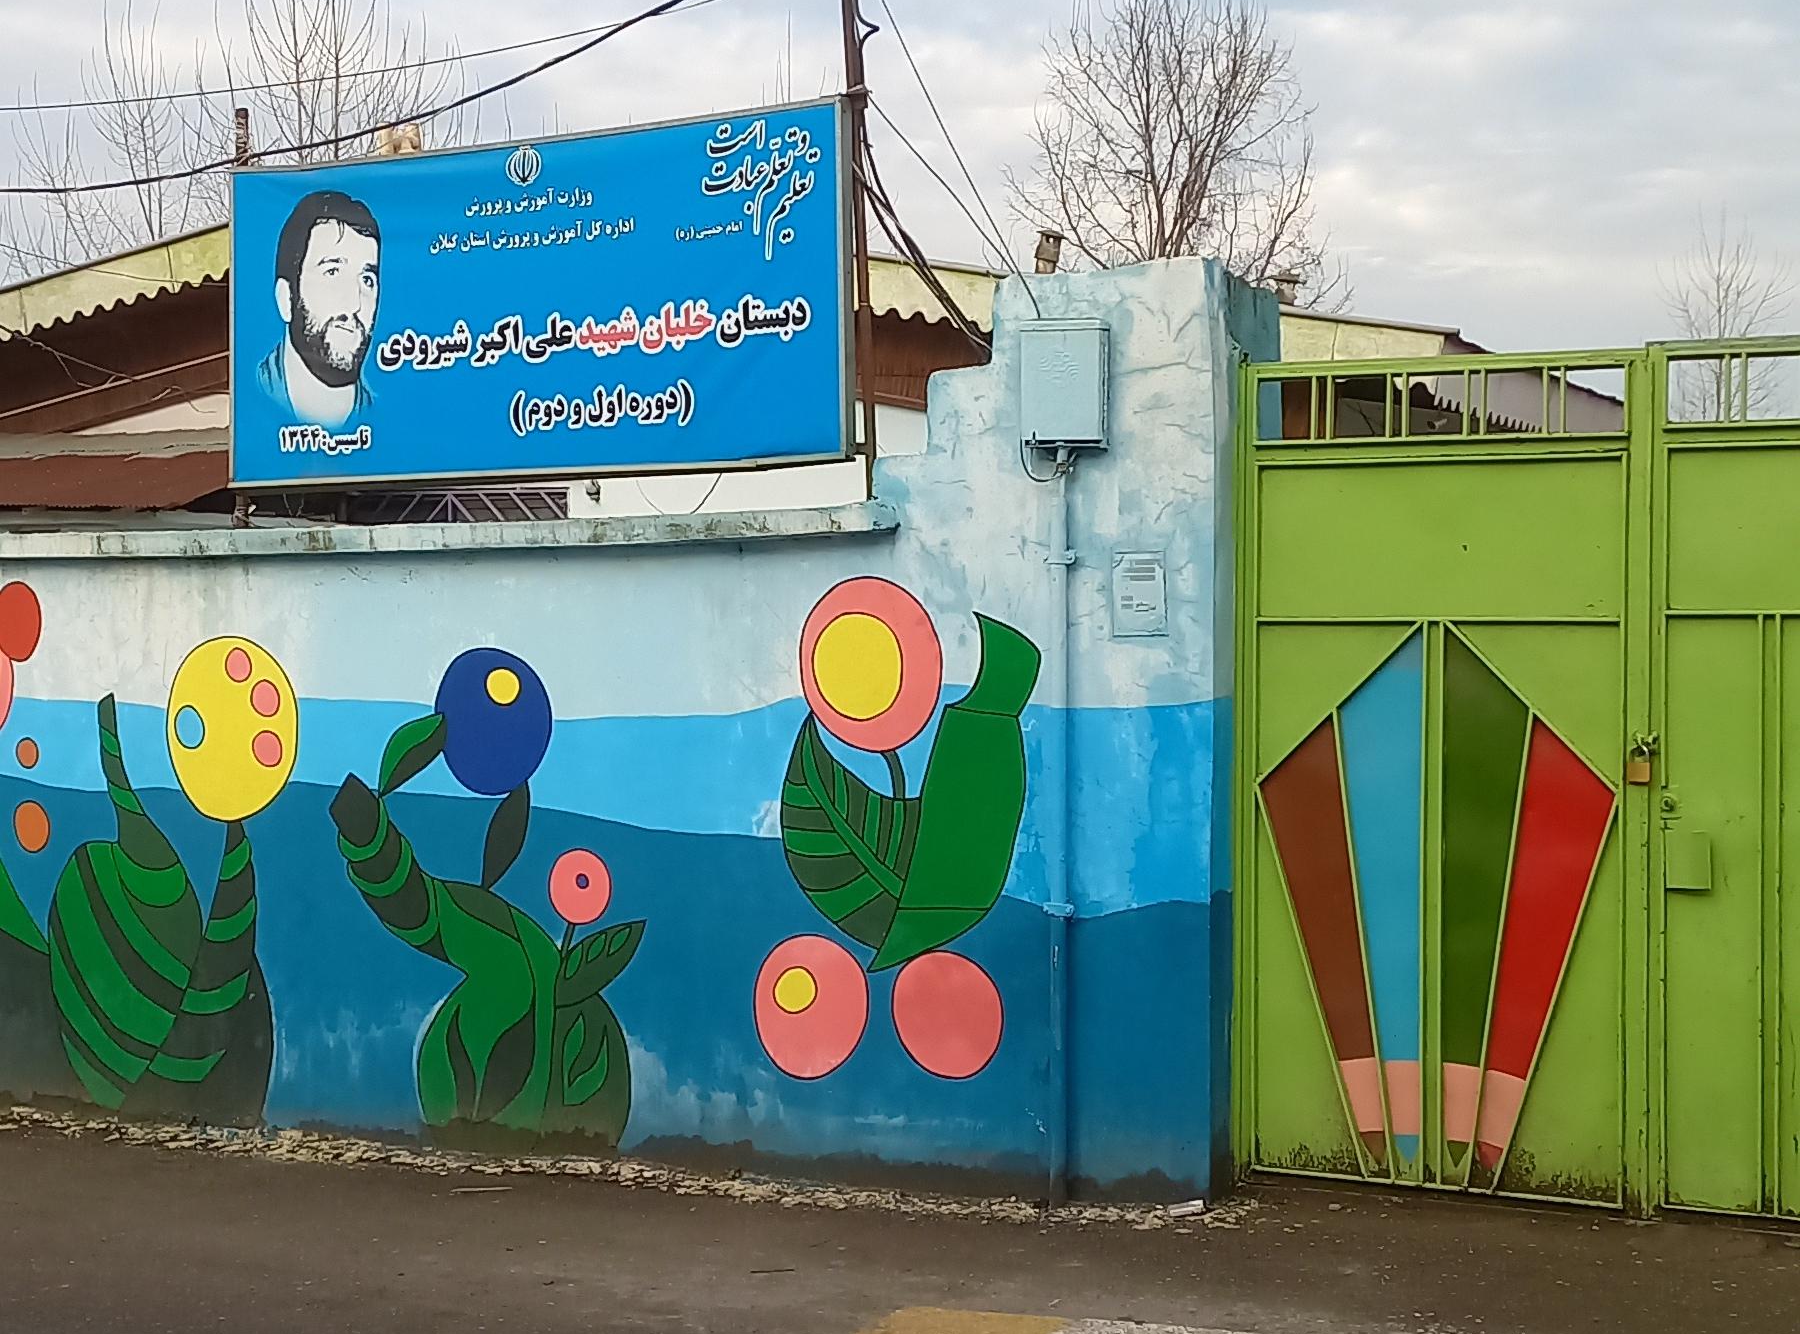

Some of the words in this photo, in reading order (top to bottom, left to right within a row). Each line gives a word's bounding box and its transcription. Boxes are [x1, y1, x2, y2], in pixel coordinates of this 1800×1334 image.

[706, 120, 765, 157] است
[558, 186, 593, 208] وزارت
[702, 155, 770, 215] عبادت
[465, 195, 504, 217] پرورش
[504, 198, 513, 214] و
[514, 187, 555, 214] آموزش
[460, 230, 490, 252] استان
[492, 229, 531, 249] پرورش
[532, 232, 540, 246] و
[542, 220, 584, 245] آموزش
[585, 219, 603, 241] کل
[605, 217, 635, 239] اداره
[725, 220, 744, 236] امام
[577, 309, 637, 354] شهید
[641, 302, 715, 351] خلبان
[718, 297, 809, 345] دبستان
[379, 322, 470, 368] شیرودی
[473, 317, 521, 365] اکبر
[525, 314, 574, 361] علی
[511, 392, 566, 435] دوم)
[569, 401, 583, 426] و
[587, 387, 624, 425] اول
[627, 380, 693, 425] (دوره
